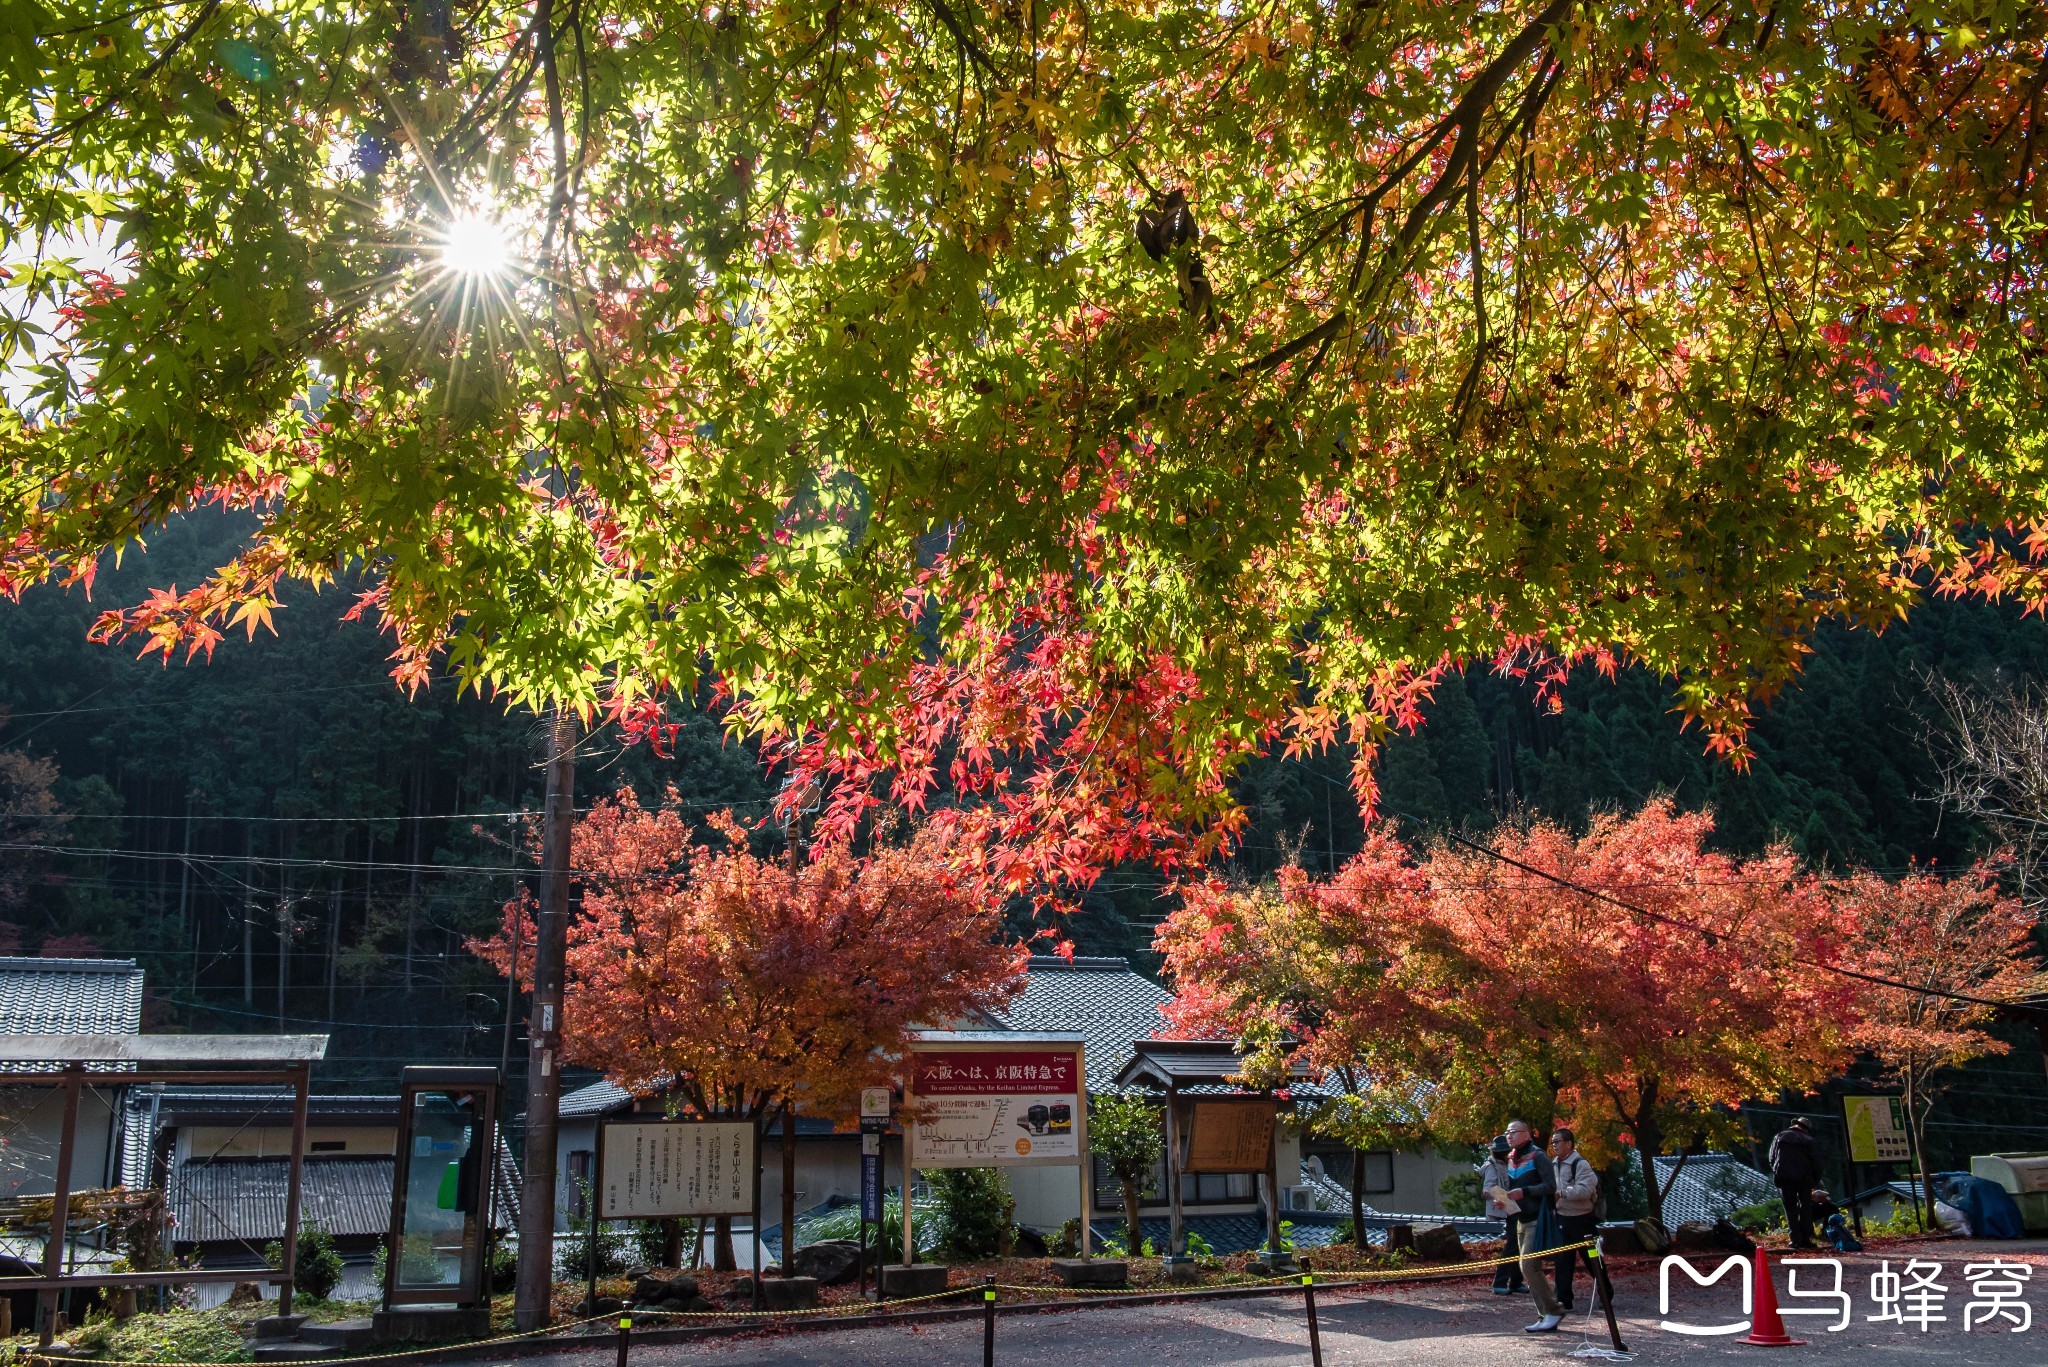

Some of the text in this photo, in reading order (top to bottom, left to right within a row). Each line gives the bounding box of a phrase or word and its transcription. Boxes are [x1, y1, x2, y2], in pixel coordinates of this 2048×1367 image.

[731, 1132, 741, 1201] くらま山入山心得
